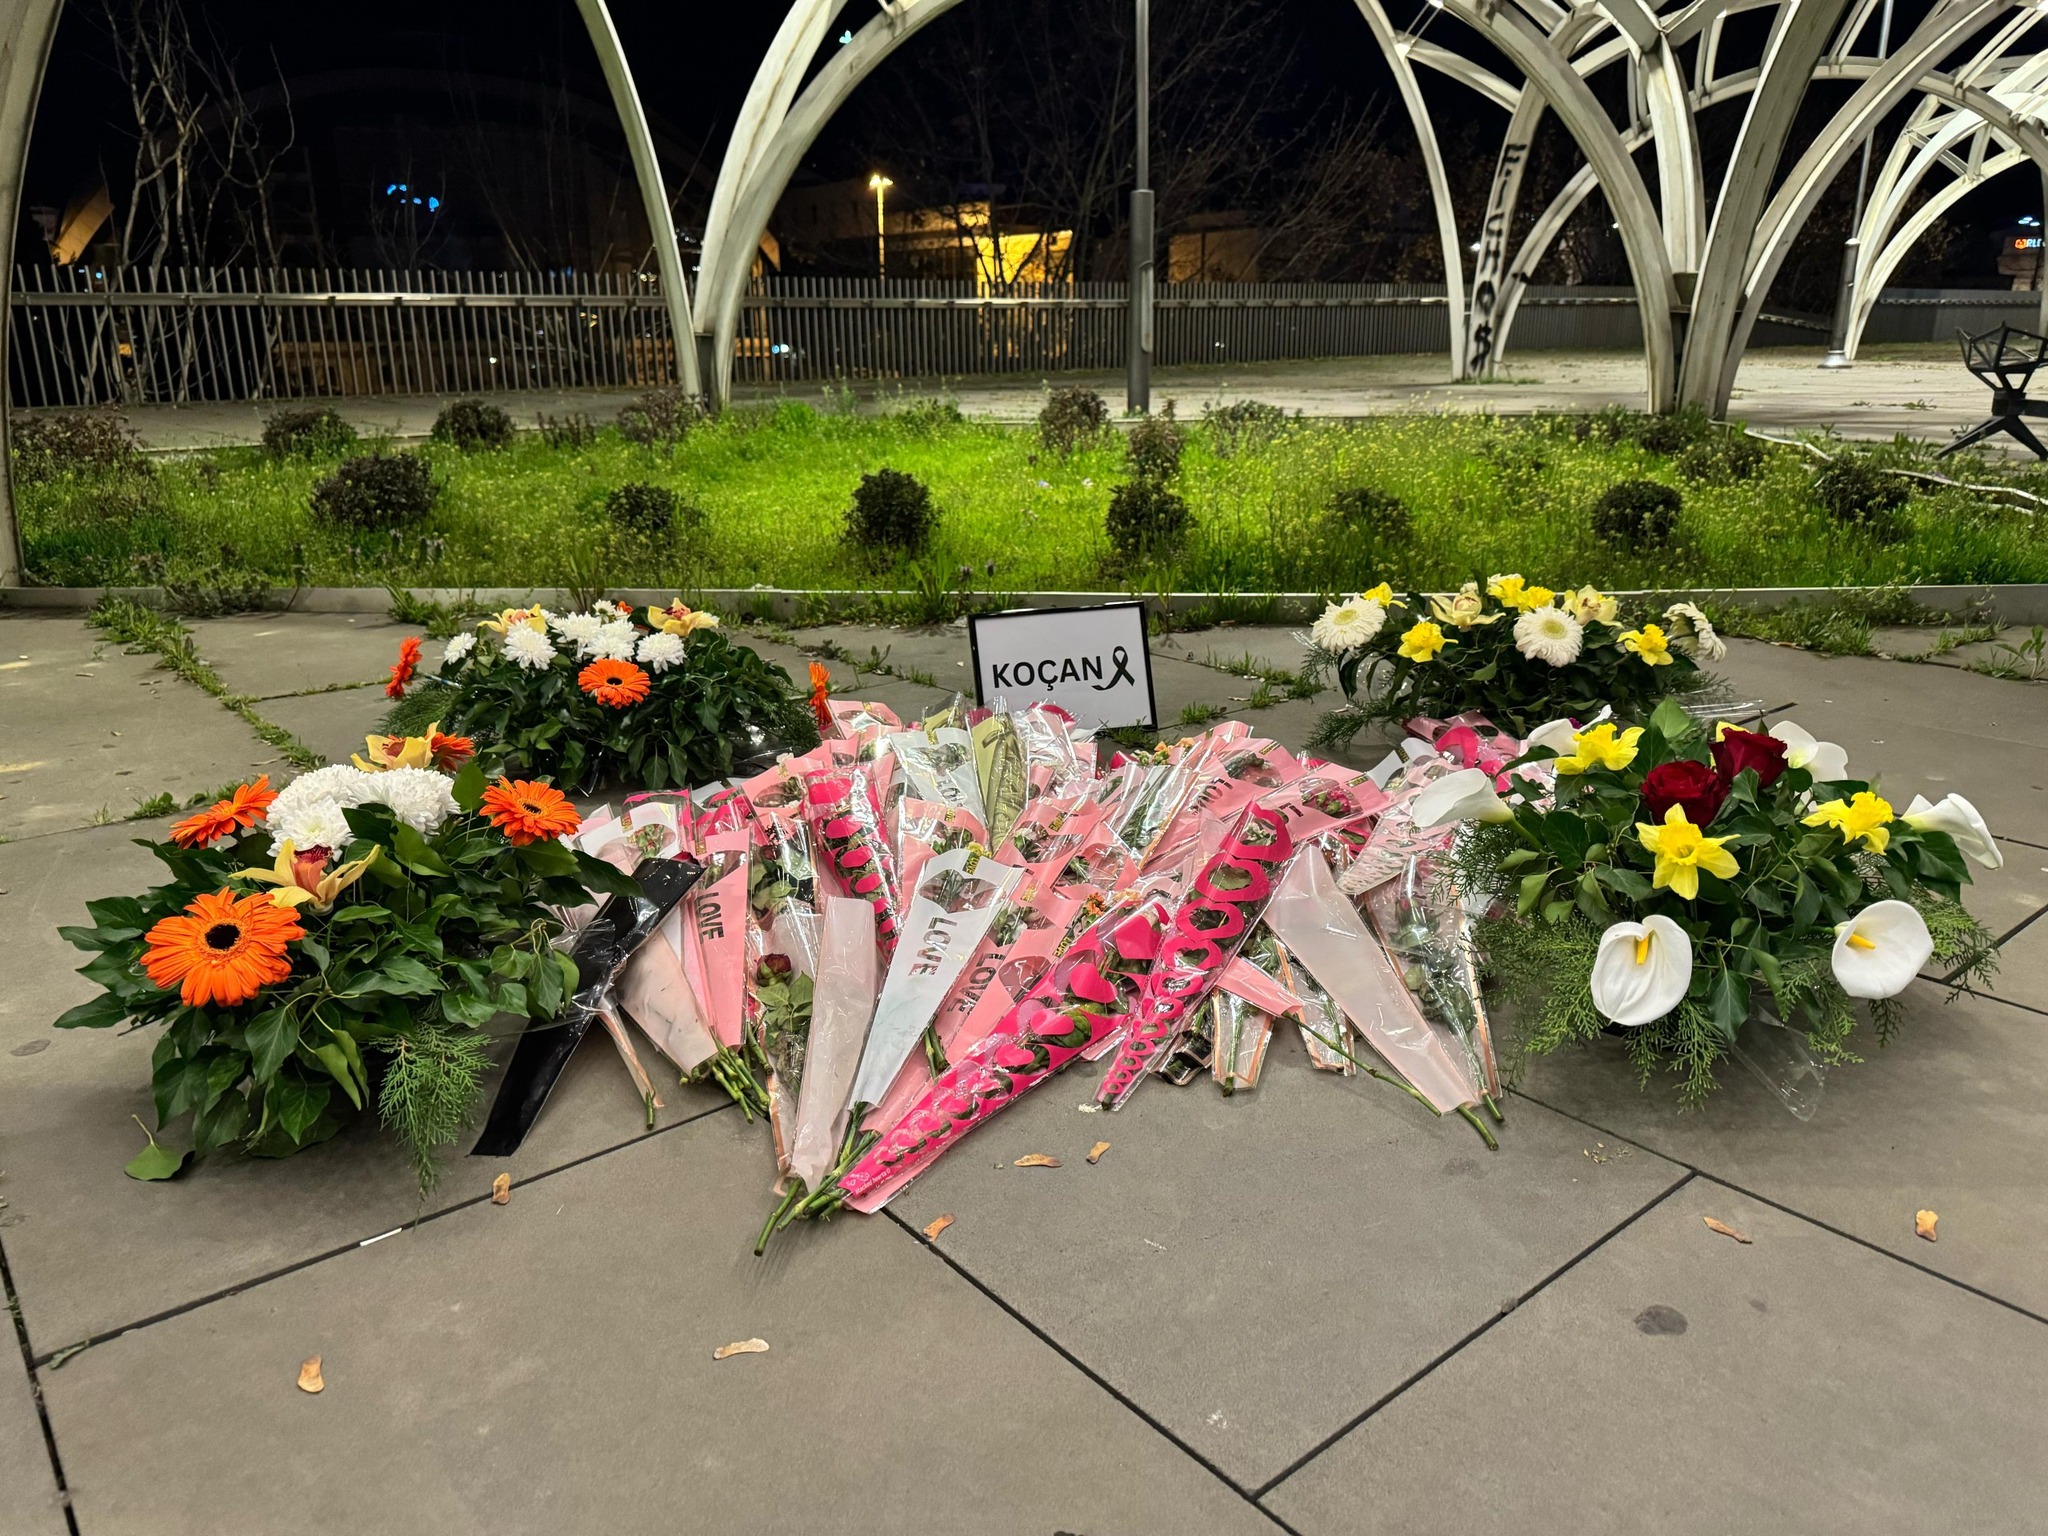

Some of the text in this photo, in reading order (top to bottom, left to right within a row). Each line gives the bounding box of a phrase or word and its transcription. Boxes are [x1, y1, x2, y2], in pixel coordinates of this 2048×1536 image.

[992, 656, 1103, 691] KOÇAN
[694, 892, 724, 945] LOVE
[908, 917, 958, 977] LOVE
[1053, 934, 1072, 959] LOVE
[947, 953, 1006, 1016] LOVE
